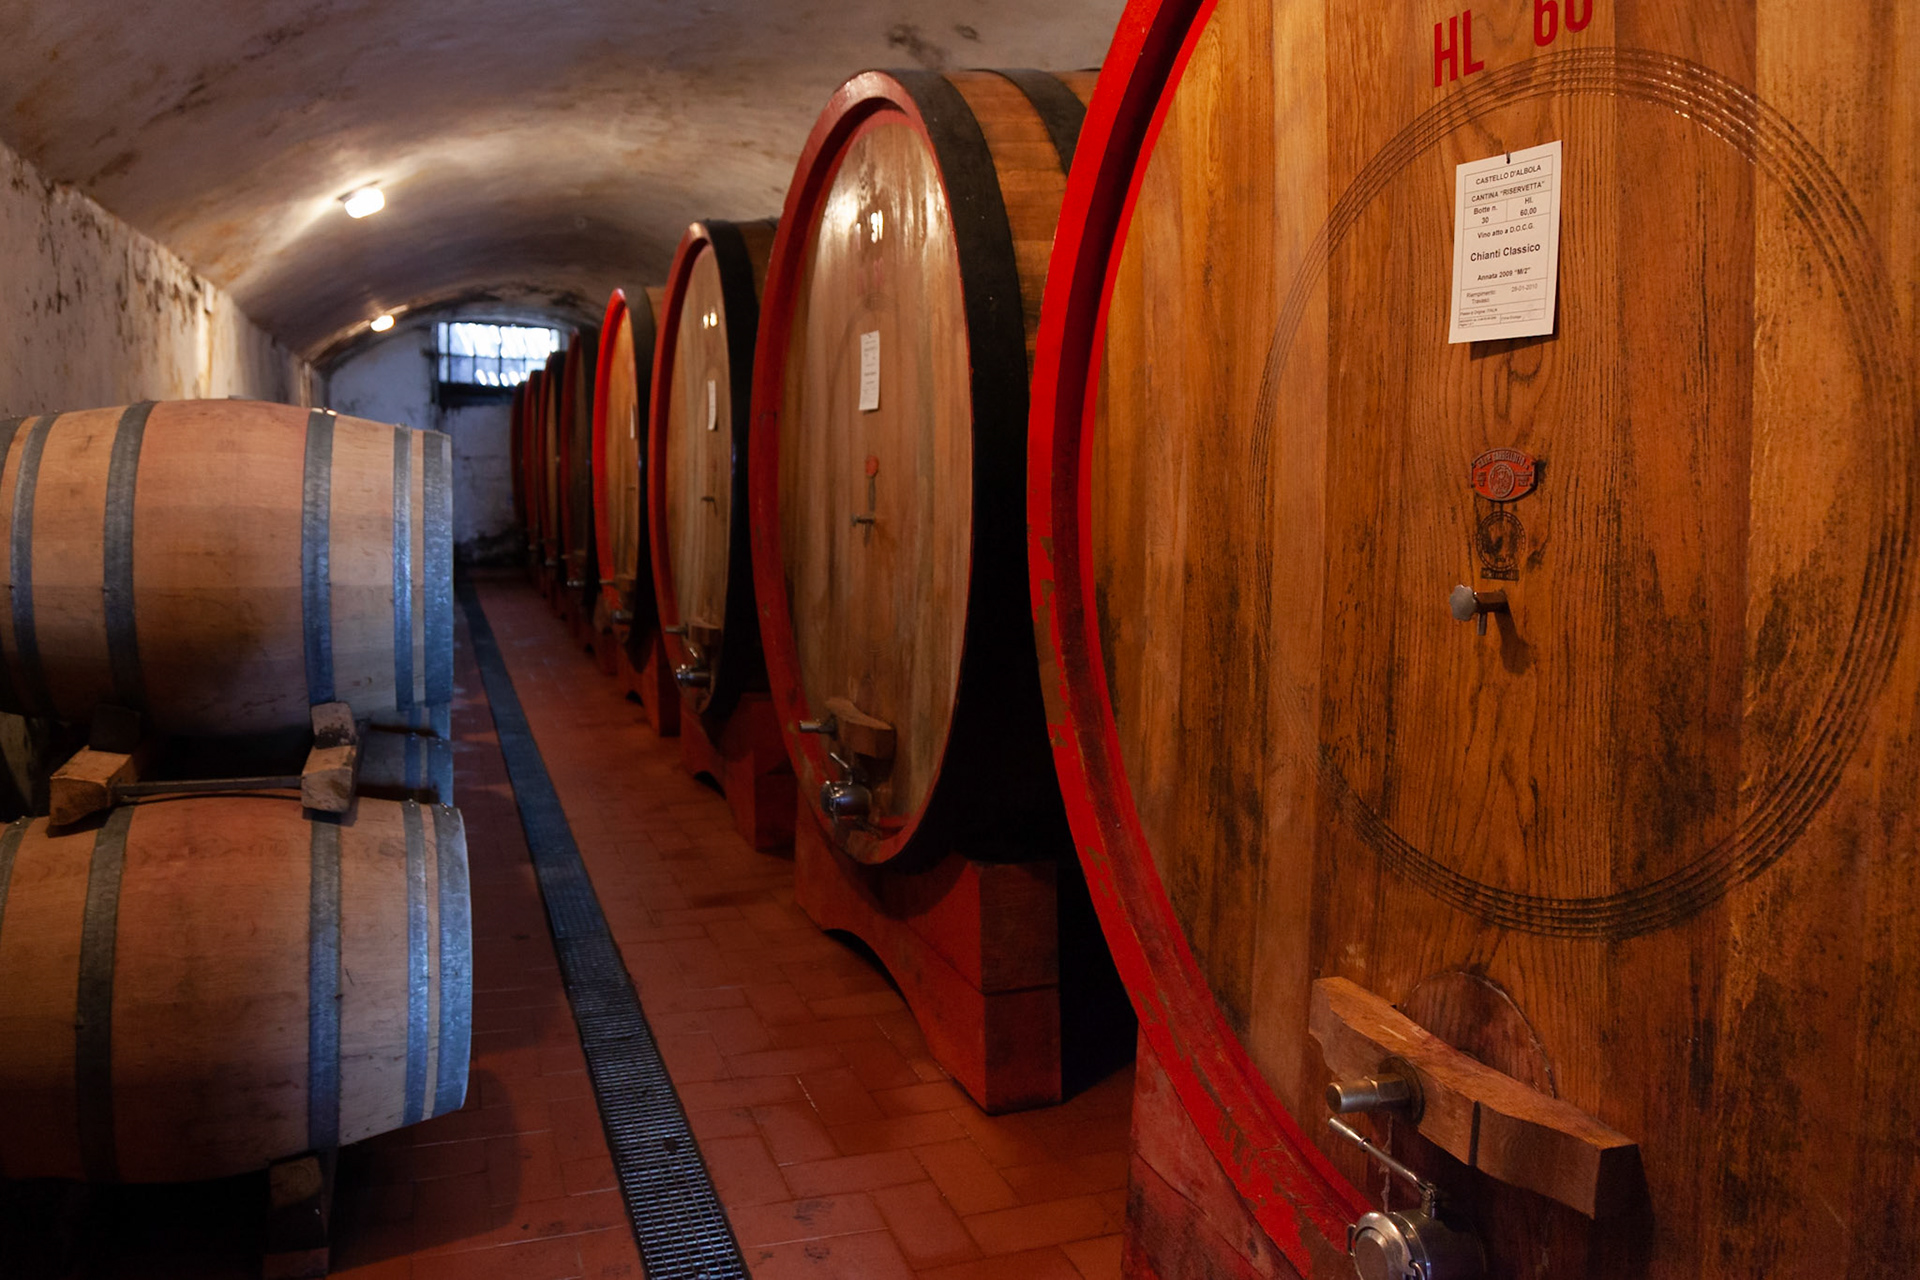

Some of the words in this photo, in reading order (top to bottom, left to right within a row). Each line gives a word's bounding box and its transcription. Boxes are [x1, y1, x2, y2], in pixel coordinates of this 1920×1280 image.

[1434, 9, 1484, 88] HL
[1475, 172, 1509, 185] CASTELLO
[1510, 164, 1541, 178] D'ALBOLA
[1471, 191, 1498, 202] CANTINA
[1474, 206, 1490, 215] Botte
[1481, 216, 1489, 224] 30
[1477, 231, 1491, 239] Vino
[1492, 229, 1503, 237] atto
[1509, 223, 1535, 234] D.O.C.G.
[1470, 248, 1501, 262] Chianti
[1503, 243, 1541, 257] Classico
[1477, 273, 1498, 281] Annata
